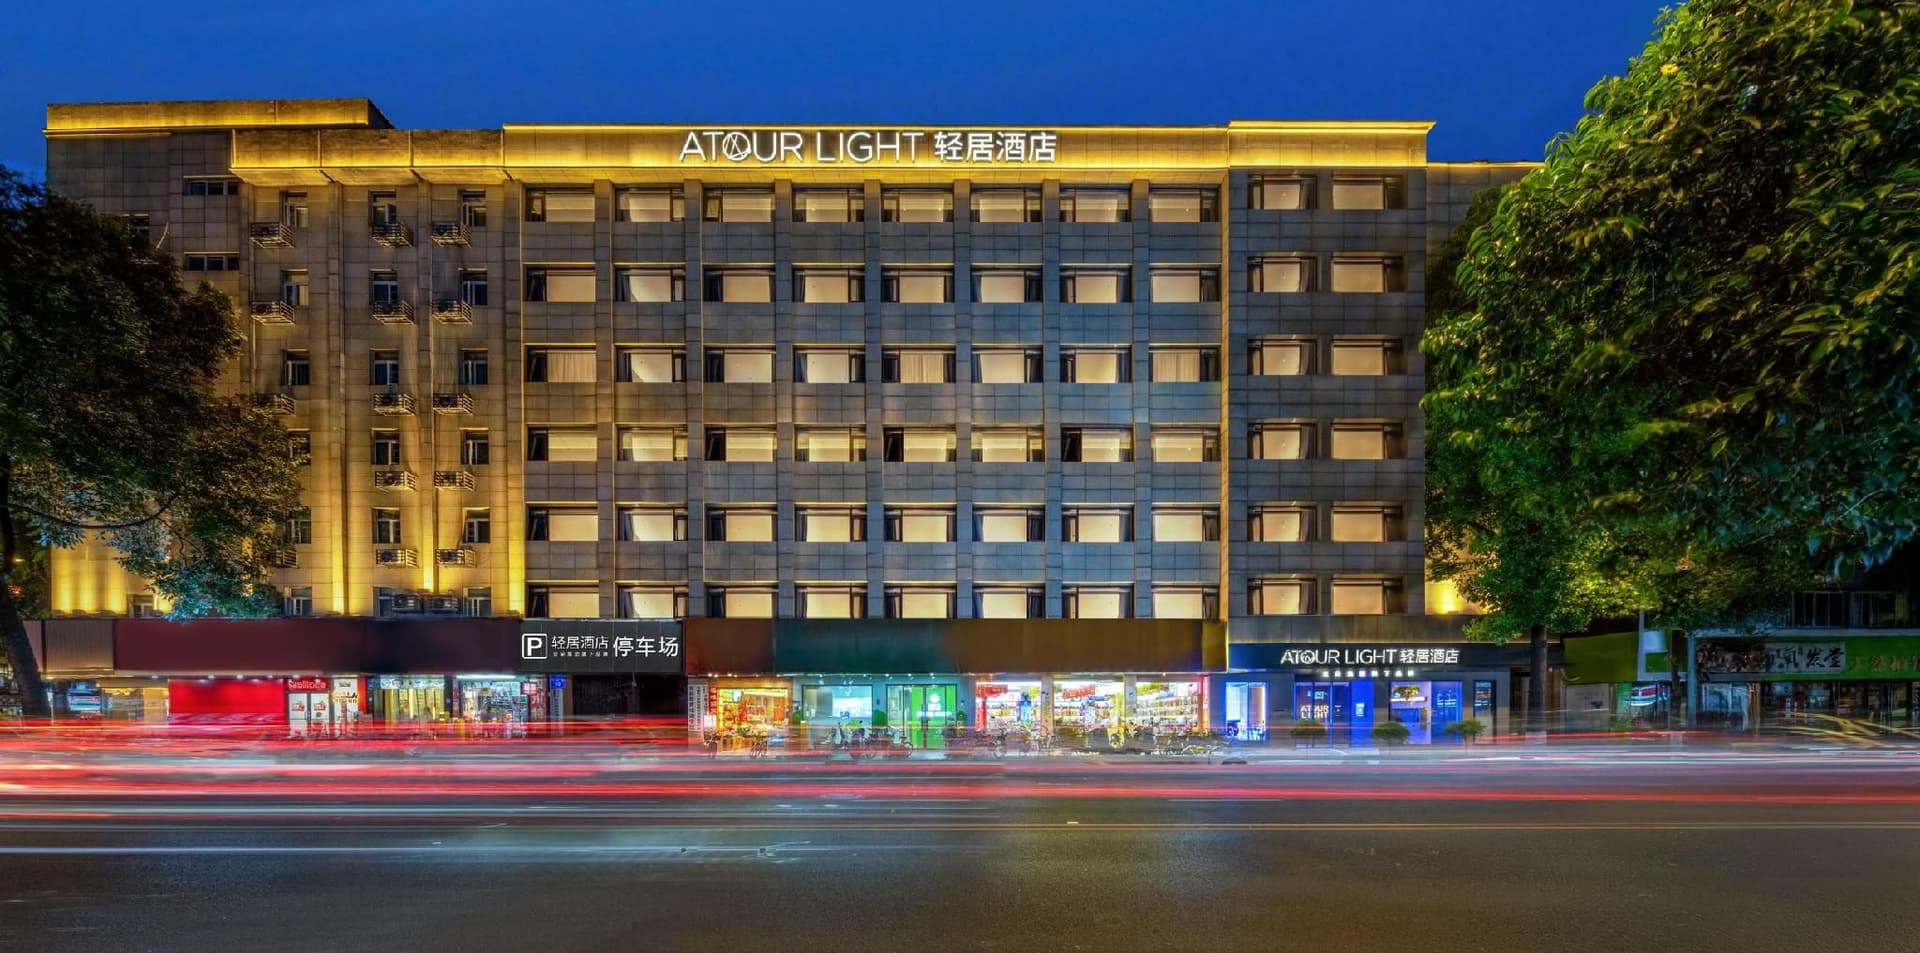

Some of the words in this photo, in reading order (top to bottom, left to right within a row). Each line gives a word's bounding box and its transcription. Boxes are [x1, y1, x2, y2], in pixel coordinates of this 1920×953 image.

[679, 131, 803, 162] ATOUR
[816, 131, 925, 162] LIGHT
[933, 131, 1057, 162] 轻居酒店
[526, 637, 544, 656] P
[551, 635, 609, 650] 轻居酒店
[612, 635, 679, 658] 停车场
[1280, 649, 1341, 665] ATOUR
[1343, 649, 1397, 665] LIGHT
[1399, 648, 1460, 665] 轻居酒店
